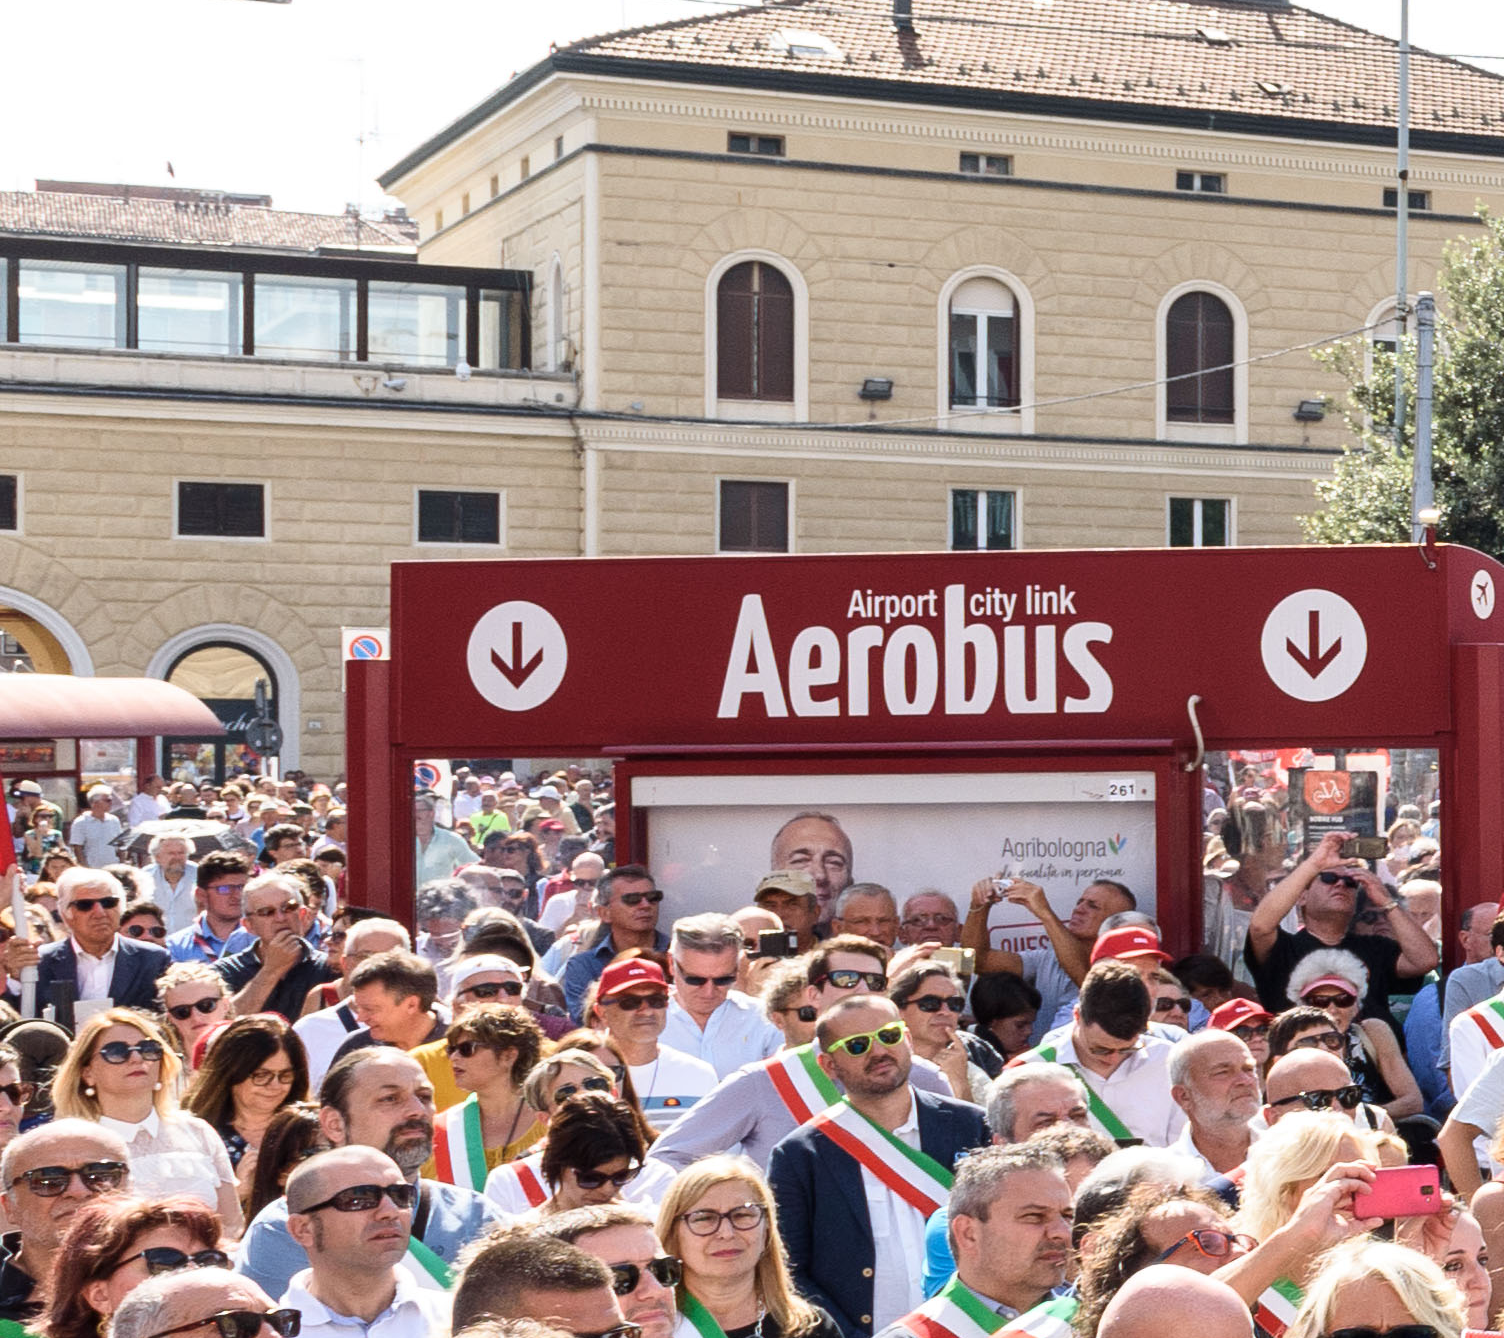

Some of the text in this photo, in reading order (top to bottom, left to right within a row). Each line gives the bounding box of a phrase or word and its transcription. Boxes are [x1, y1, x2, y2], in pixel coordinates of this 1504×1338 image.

[847, 585, 1076, 623] Airport city link
[717, 584, 1113, 718] Aerobus
[1109, 784, 1135, 796] 261
[1002, 837, 1106, 861] Agribologna
